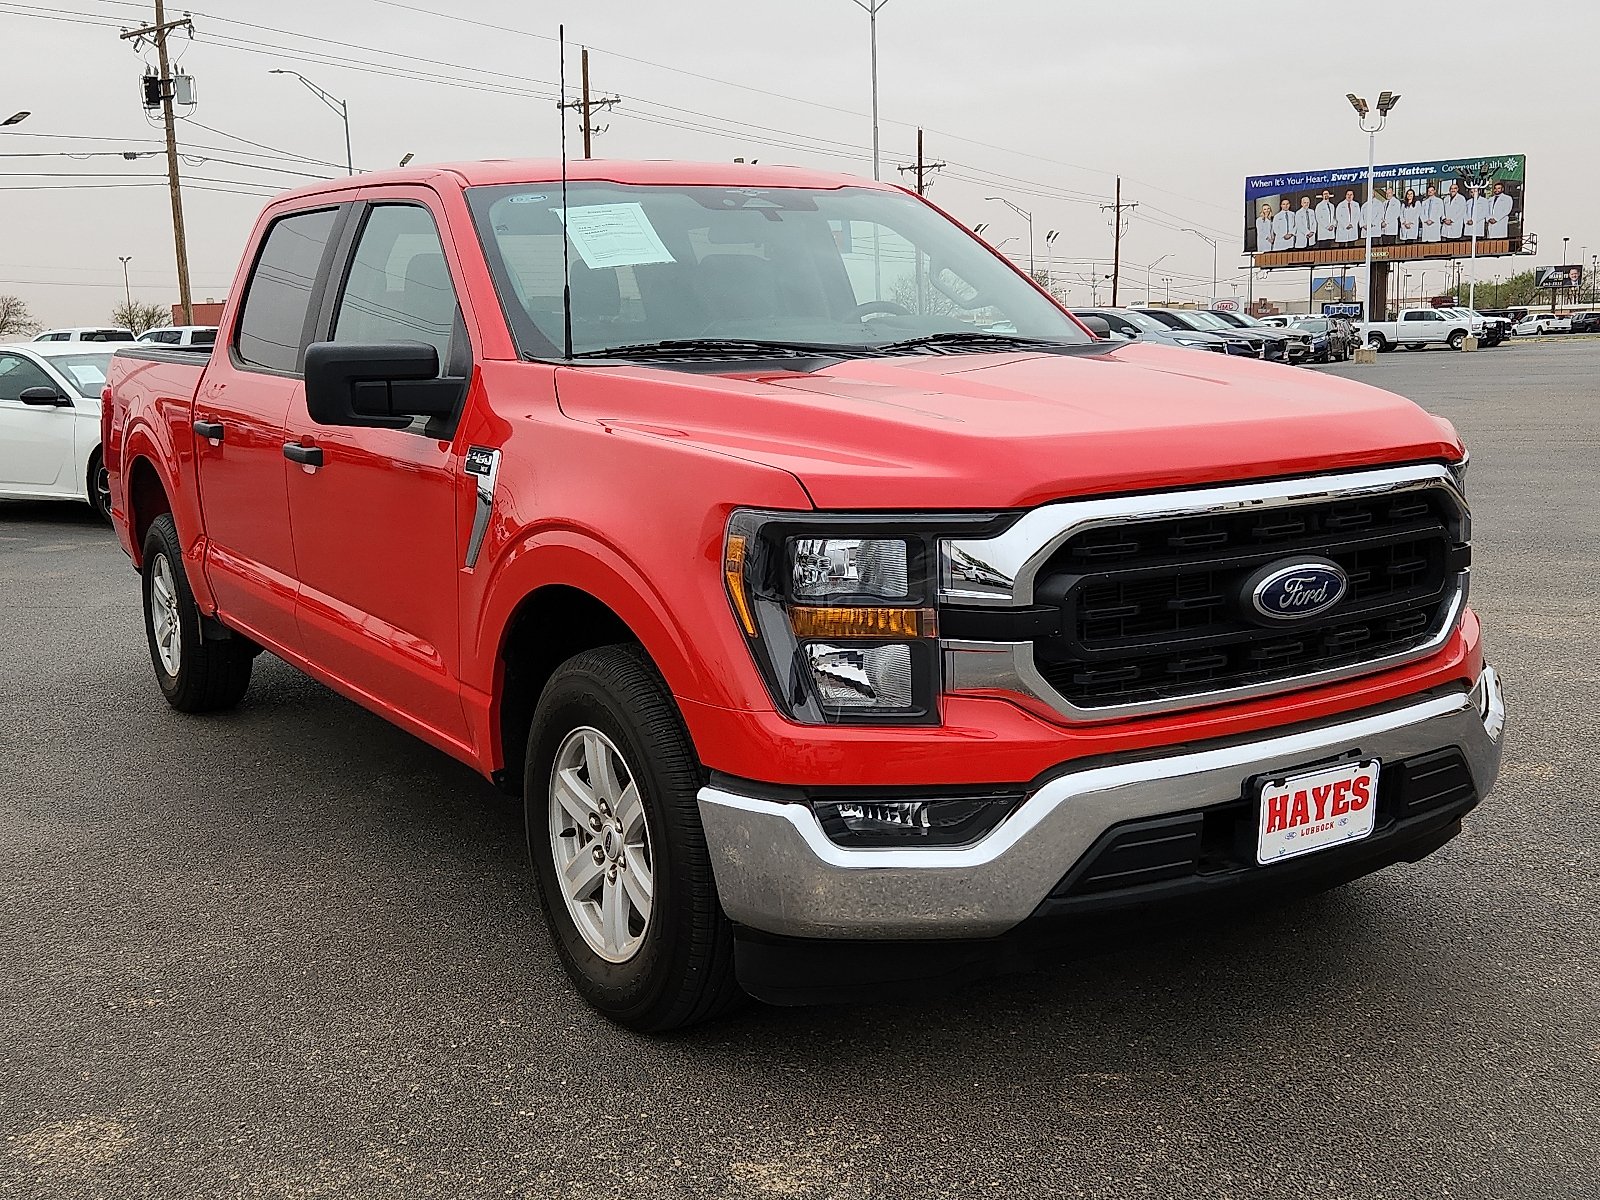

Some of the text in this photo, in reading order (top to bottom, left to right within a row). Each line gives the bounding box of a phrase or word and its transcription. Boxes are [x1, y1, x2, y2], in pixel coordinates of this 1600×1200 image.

[1250, 179, 1273, 188] When
[1274, 178, 1285, 186] It's
[1286, 177, 1304, 185] Your
[1305, 175, 1330, 184] Heart,
[1331, 172, 1358, 182] Every
[1398, 166, 1437, 176] Matters.
[1324, 303, 1361, 317] Garage
[1279, 576, 1329, 609] Ford
[1265, 775, 1371, 835] HAYES
[1300, 821, 1335, 837] LUBBOCK
